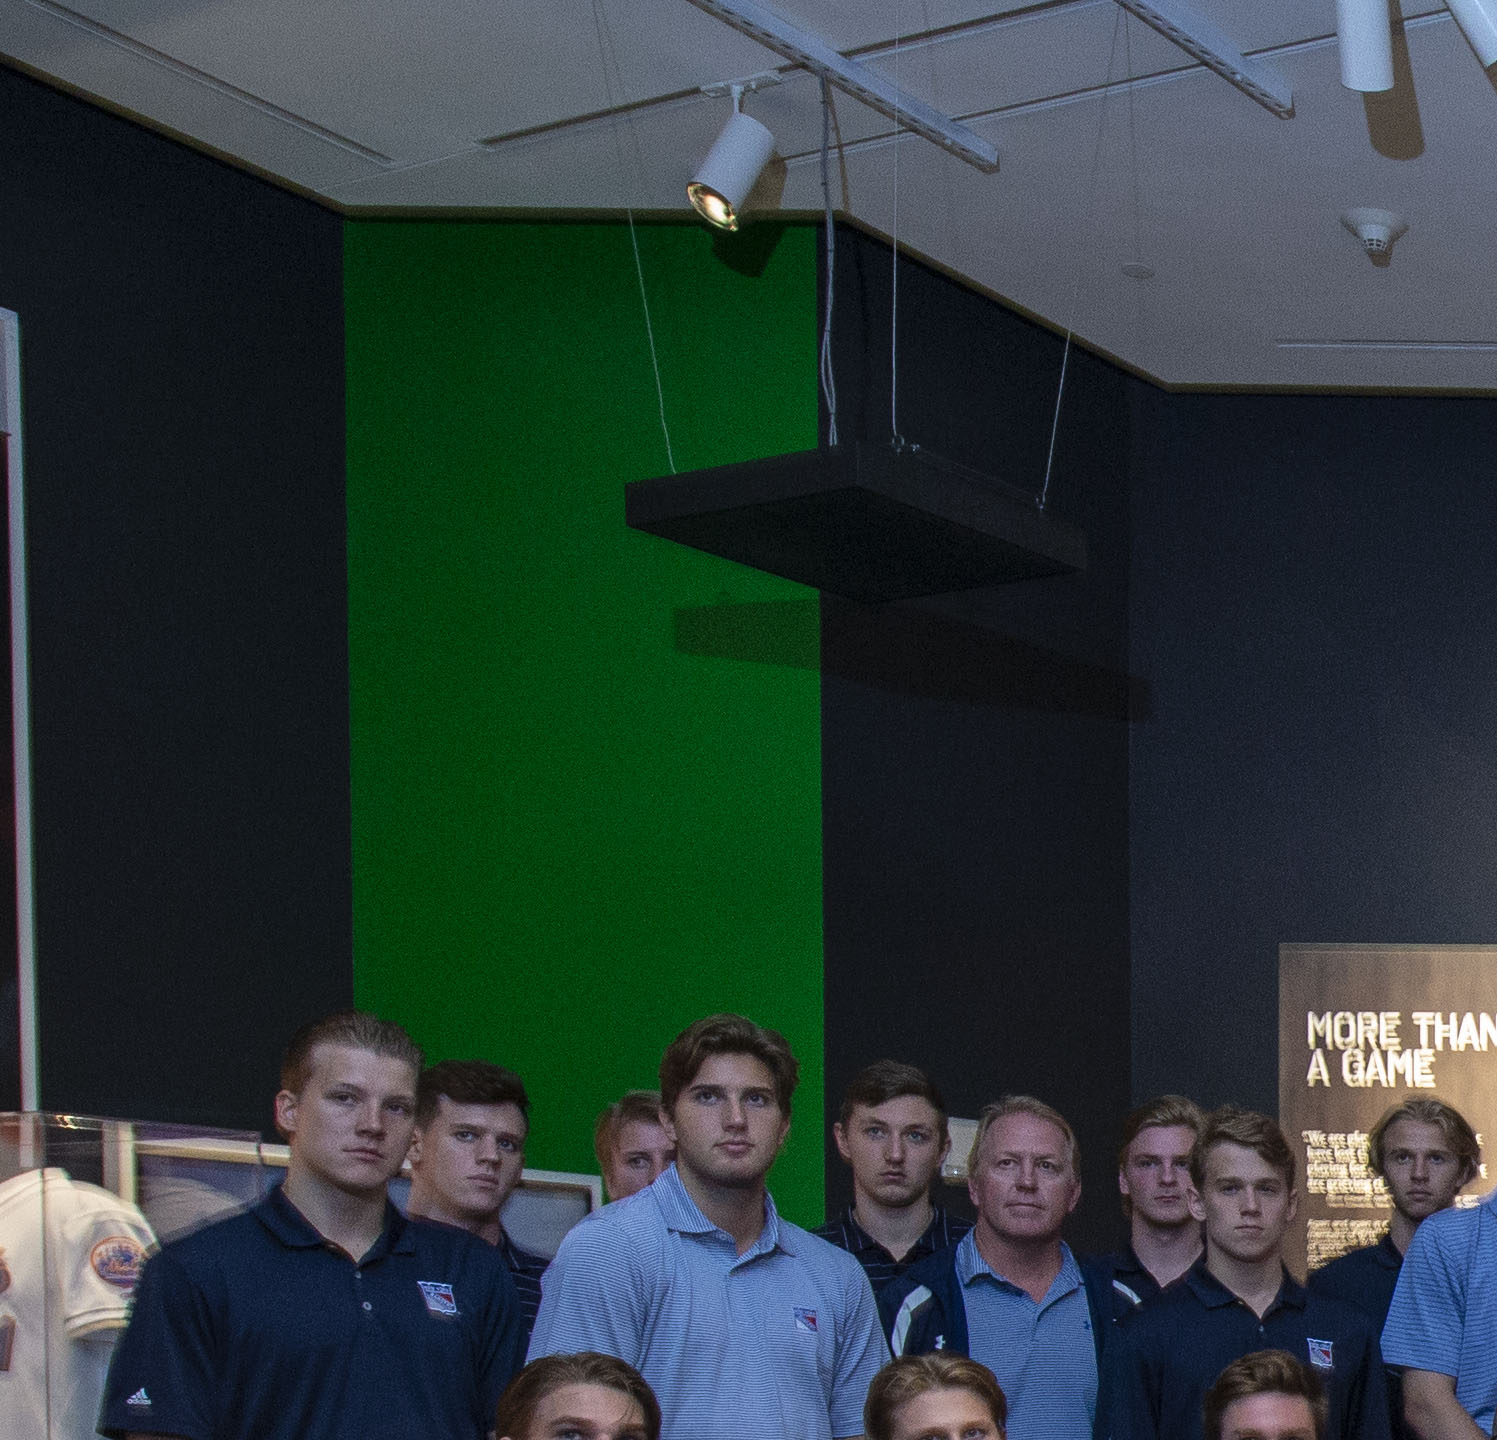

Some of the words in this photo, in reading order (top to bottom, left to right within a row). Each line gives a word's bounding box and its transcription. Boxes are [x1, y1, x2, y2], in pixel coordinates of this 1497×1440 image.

[1307, 1011, 1402, 1050] MORE
[1307, 1049, 1331, 1087] A
[1342, 1049, 1436, 1088] GAME
